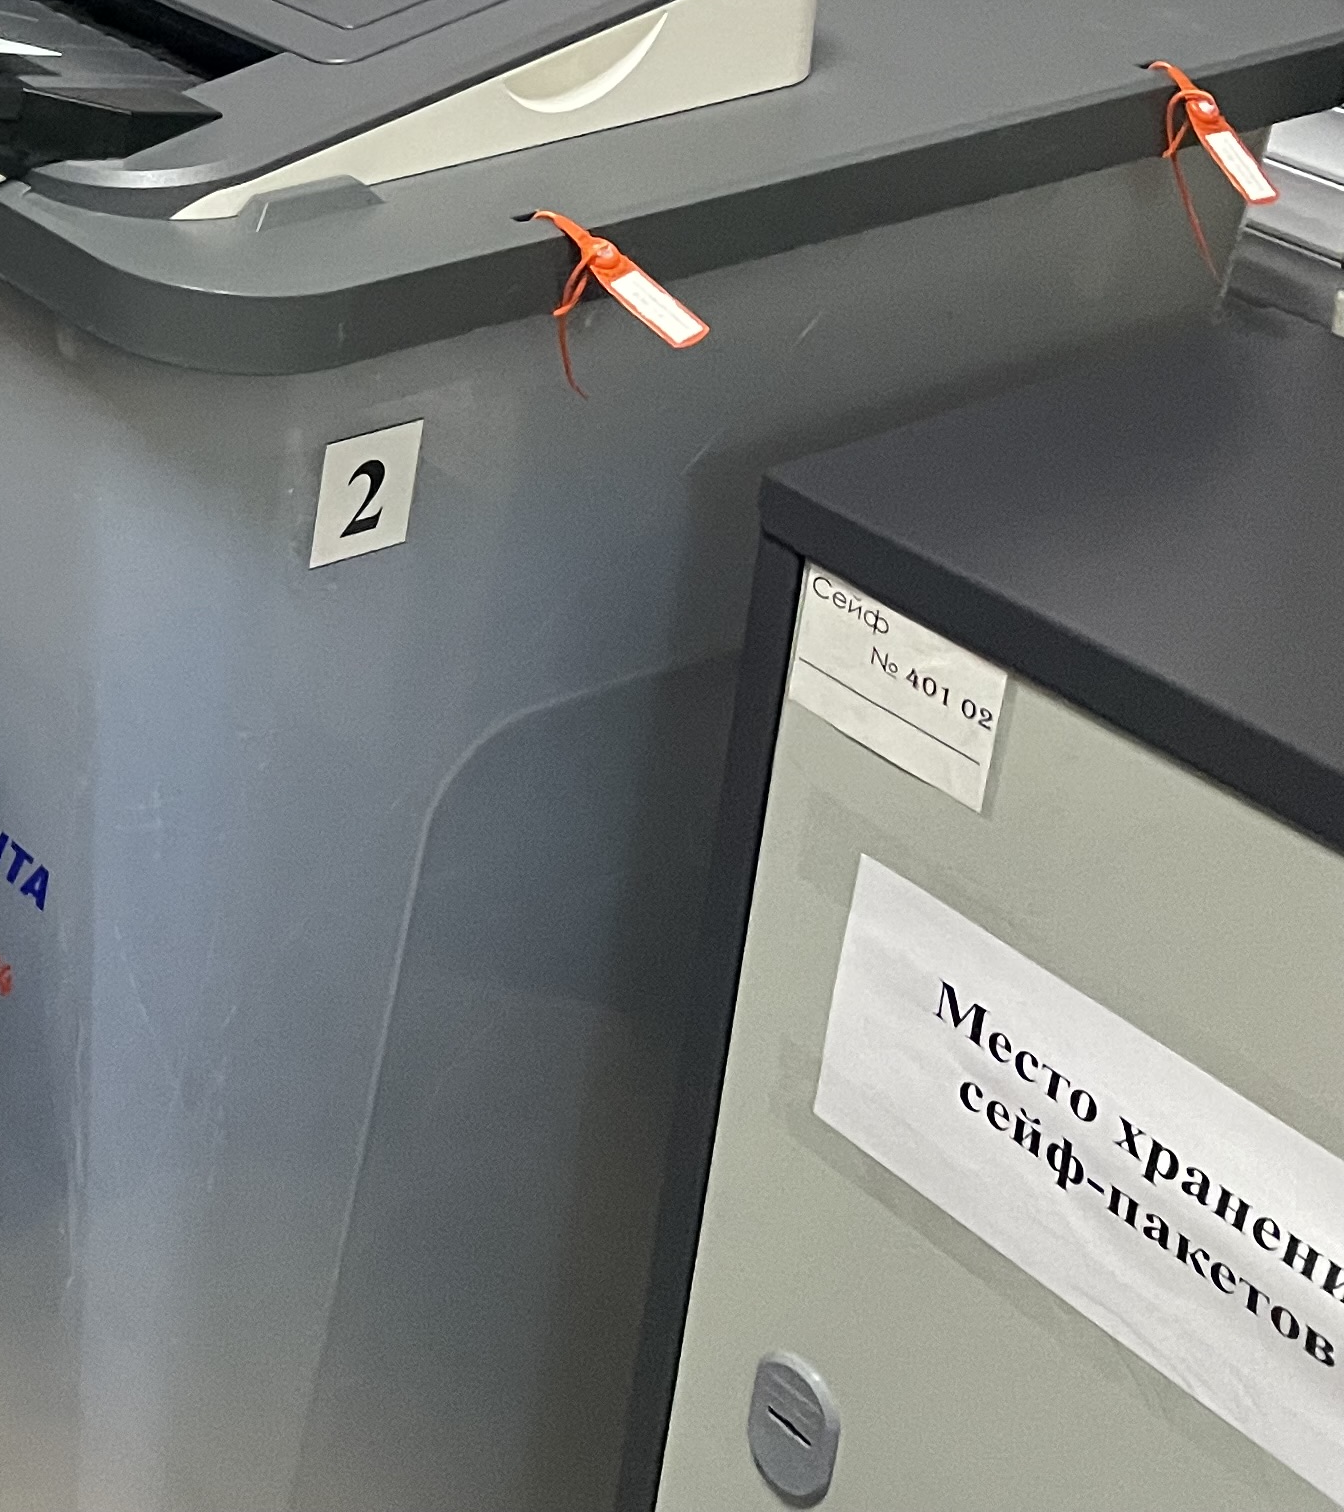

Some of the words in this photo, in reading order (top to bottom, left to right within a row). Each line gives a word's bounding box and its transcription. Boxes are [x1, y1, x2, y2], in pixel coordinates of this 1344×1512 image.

[339, 458, 386, 539] 2
[812, 575, 891, 636] Сейф
[870, 645, 900, 680] №
[904, 667, 951, 708] 401
[960, 697, 995, 732] 02
[932, 976, 1099, 1123] Место
[959, 1080, 1336, 1368] сейф-пакетов
